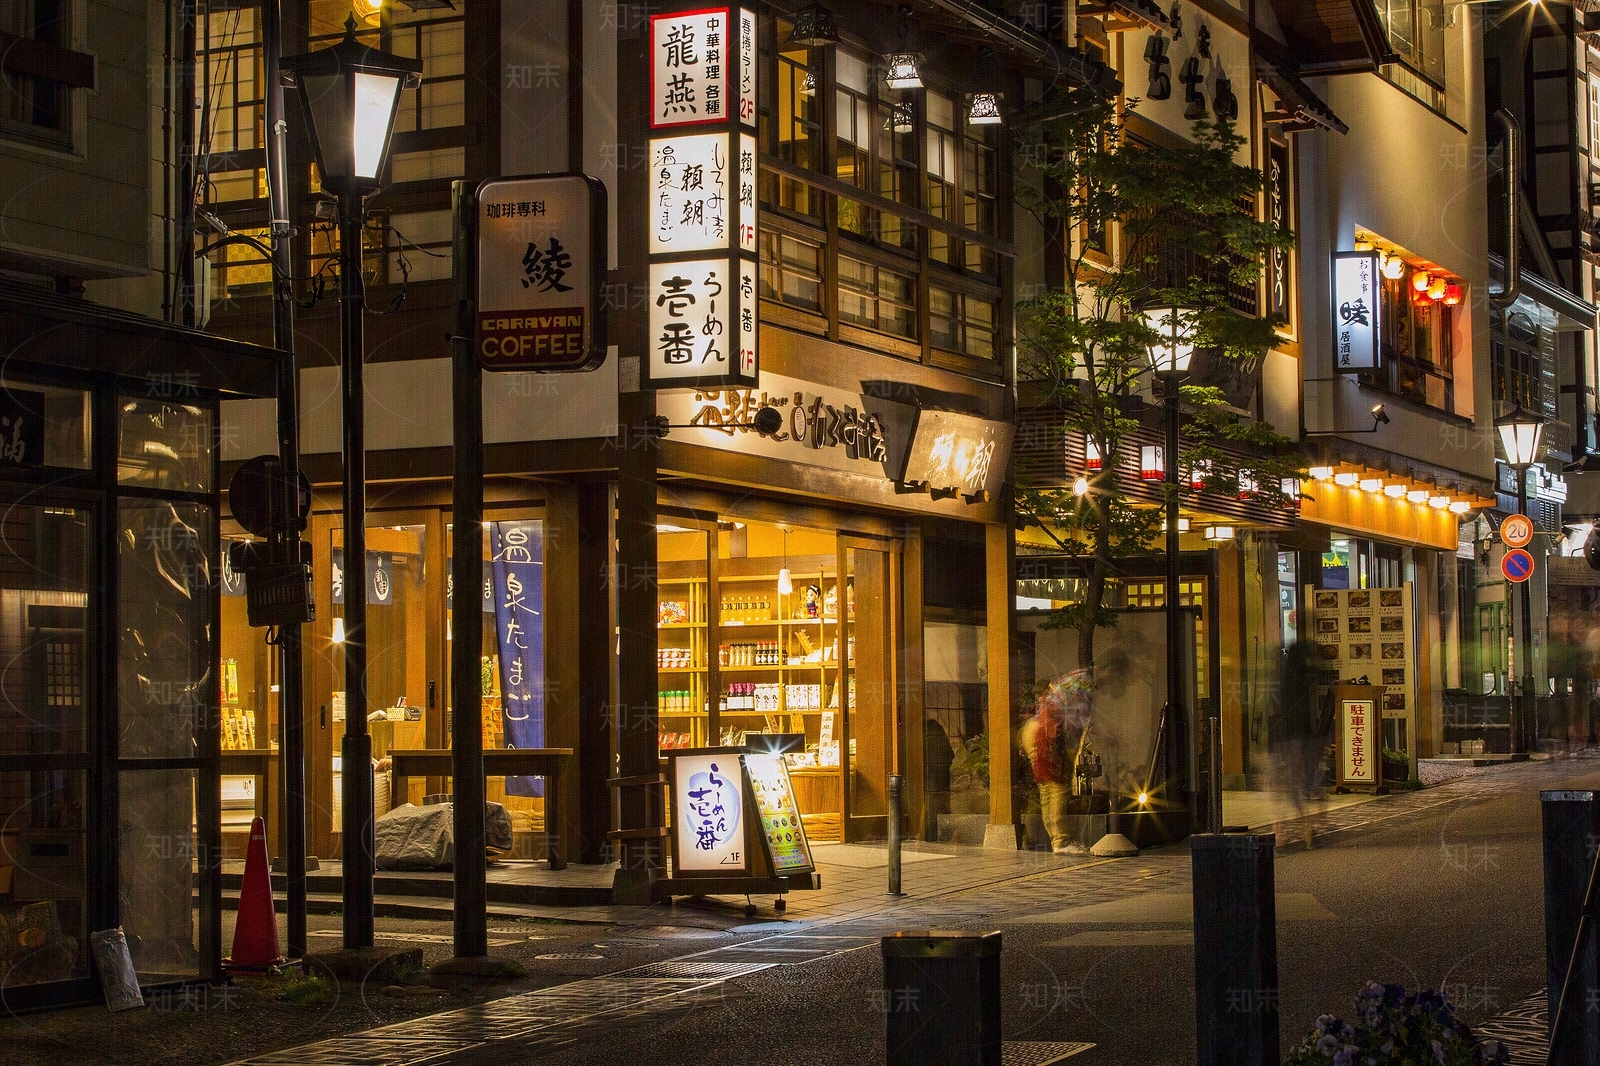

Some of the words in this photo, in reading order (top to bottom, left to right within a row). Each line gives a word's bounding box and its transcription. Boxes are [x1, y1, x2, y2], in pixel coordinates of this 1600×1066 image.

[662, 24, 699, 118] 龍燕
[740, 97, 754, 120] 2F
[653, 145, 688, 243] 温泉たまご
[680, 164, 704, 227] 頼朝
[740, 149, 753, 208] 頼朝
[486, 200, 546, 219] 珈琲専科
[740, 223, 754, 245] 1F
[521, 237, 574, 293] 綾
[482, 315, 581, 331] CARAVAN
[656, 275, 696, 364] 壱番
[702, 271, 726, 364] らーめん
[741, 275, 753, 332] 壱番
[481, 333, 581, 358] COFFEE
[740, 348, 753, 370] 1F
[1340, 331, 1351, 366] 居酒屋
[1508, 523, 1527, 539] 20
[493, 528, 543, 721] 温泉たまご
[1350, 704, 1366, 777] 駐車できません
[688, 787, 722, 851] 壱番
[709, 762, 728, 834] らーめん
[730, 852, 740, 861] 1F
